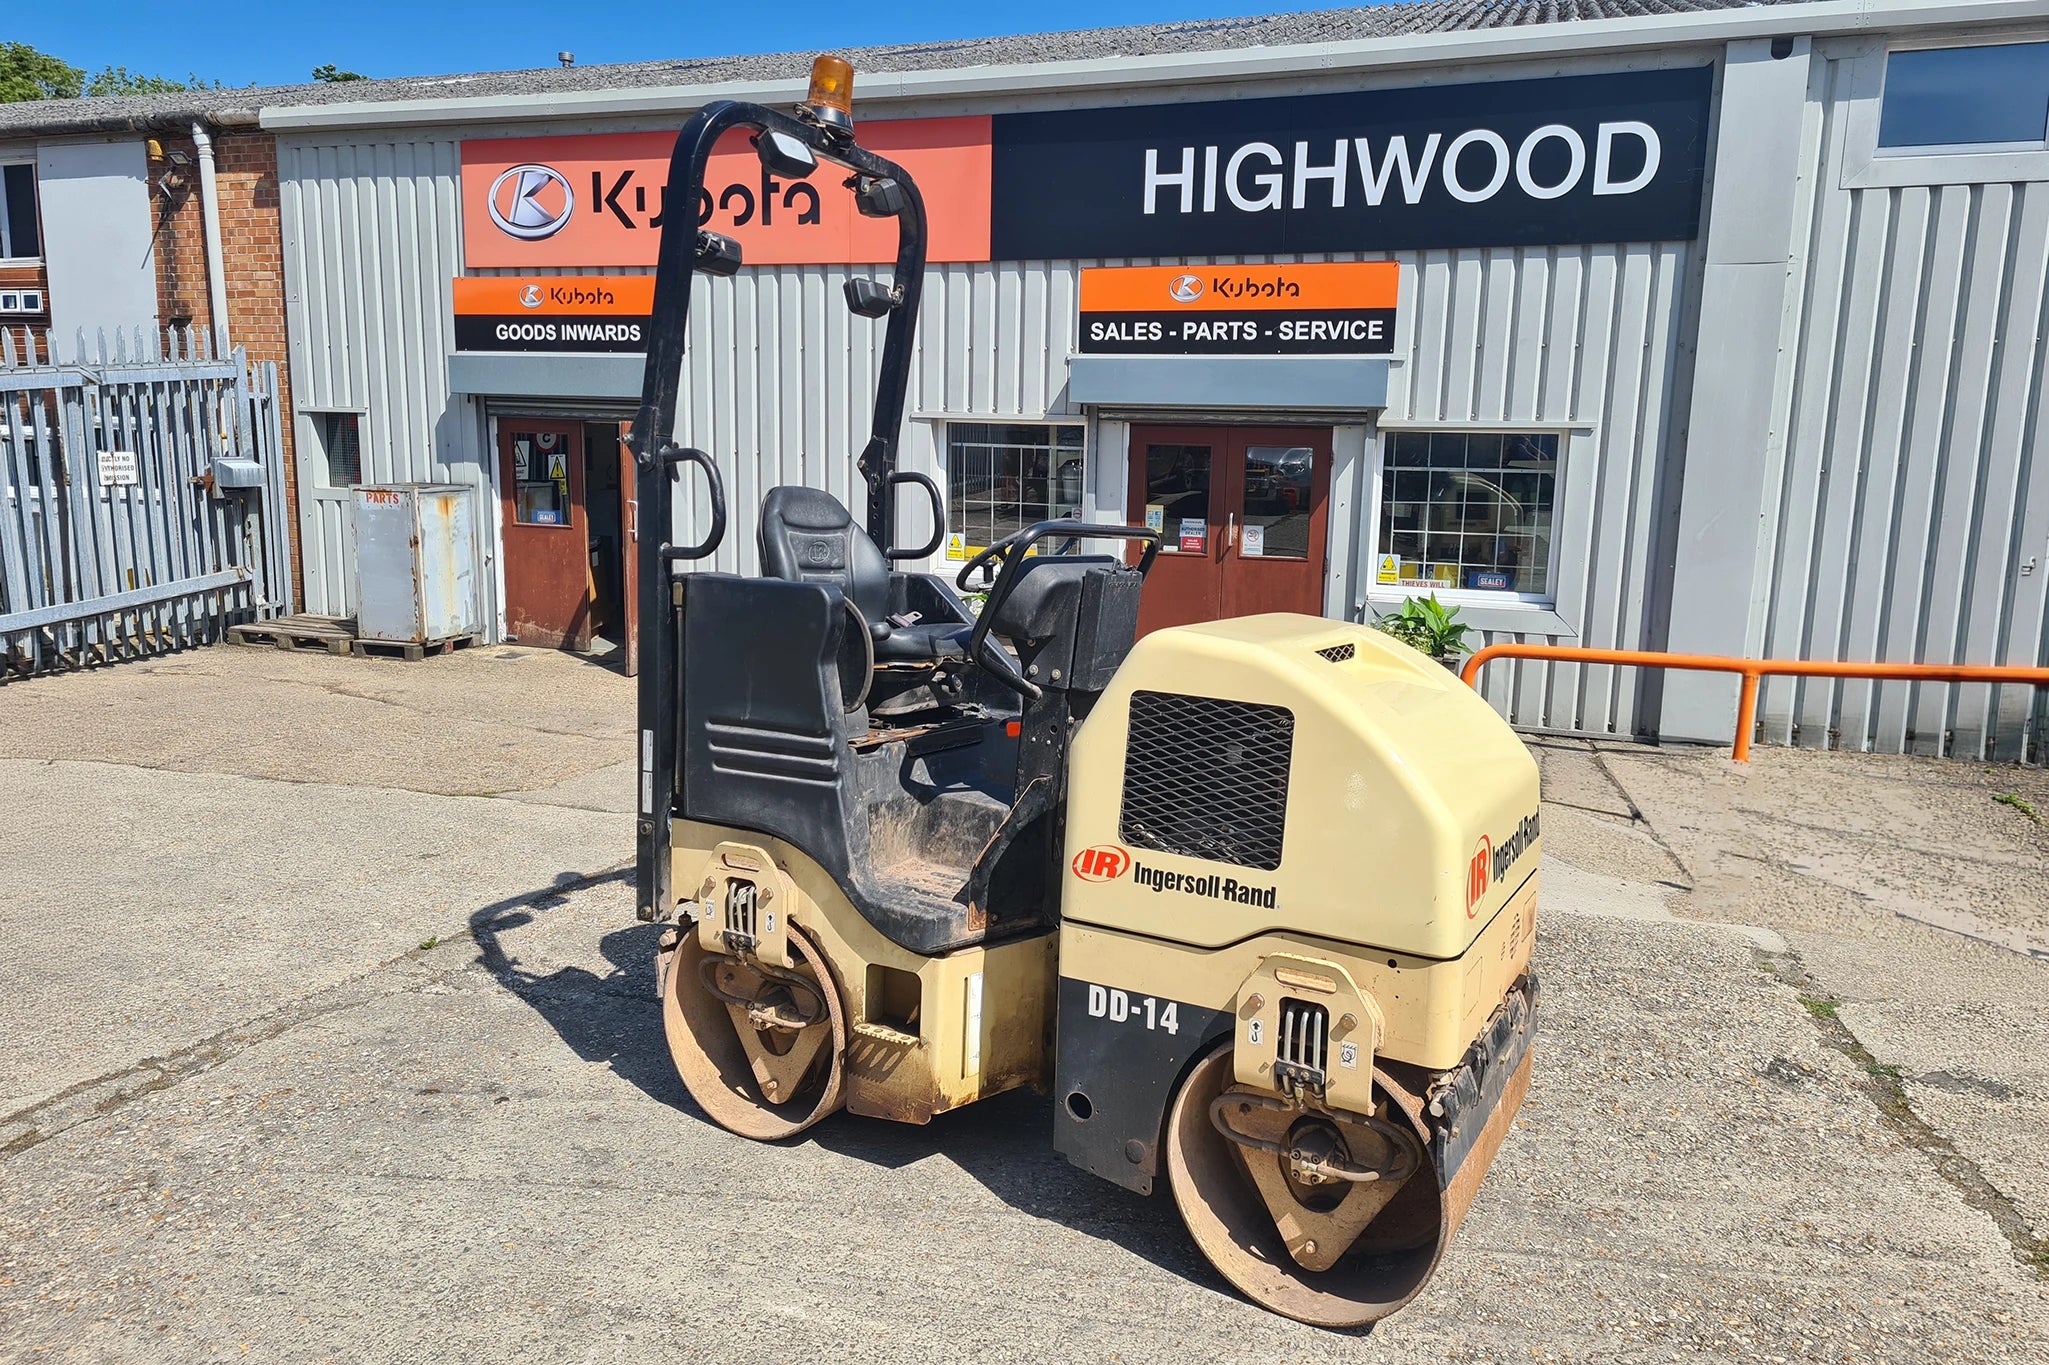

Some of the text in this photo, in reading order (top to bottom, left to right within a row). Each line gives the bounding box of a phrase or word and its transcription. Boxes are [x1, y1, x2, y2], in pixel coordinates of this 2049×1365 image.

[1144, 121, 1661, 214] HIGHWOOD
[551, 287, 614, 304] Kubota
[1213, 277, 1299, 298] Kubota
[496, 324, 641, 342] GOODS INWARDS
[1090, 322, 1163, 341] SALES
[1183, 321, 1258, 341] PARTS
[1279, 320, 1384, 340] SERVICE
[366, 492, 399, 504] PARTS
[1402, 580, 1428, 588] THIEVES
[1480, 577, 1504, 586] SEALEY
[1080, 848, 1276, 910] IR Ingersoll-Rand
[1470, 847, 1487, 908] IR
[1088, 984, 1179, 1035] DD-14
